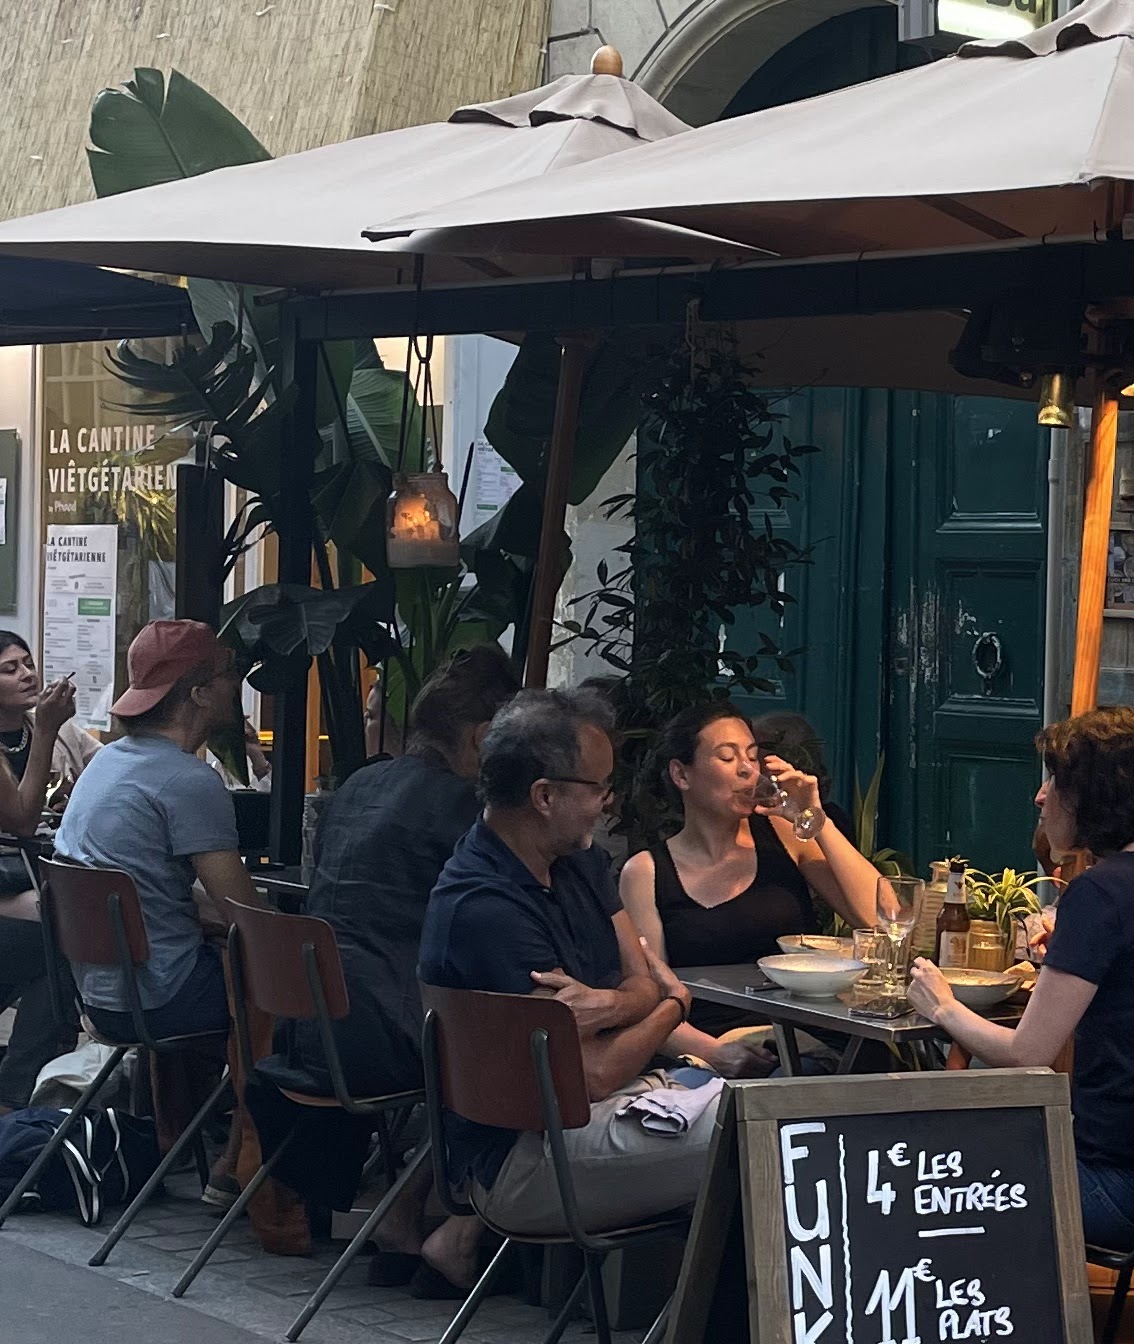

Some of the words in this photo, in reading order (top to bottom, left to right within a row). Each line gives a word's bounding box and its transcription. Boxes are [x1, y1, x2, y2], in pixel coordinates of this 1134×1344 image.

[49, 428, 71, 454] LA
[77, 424, 156, 454] CANTINE
[917, 1150, 964, 1181] LES
[914, 1169, 1028, 1215] ENTRÉES
[935, 1278, 986, 1308] LES
[938, 1306, 1014, 1341] PLATS
